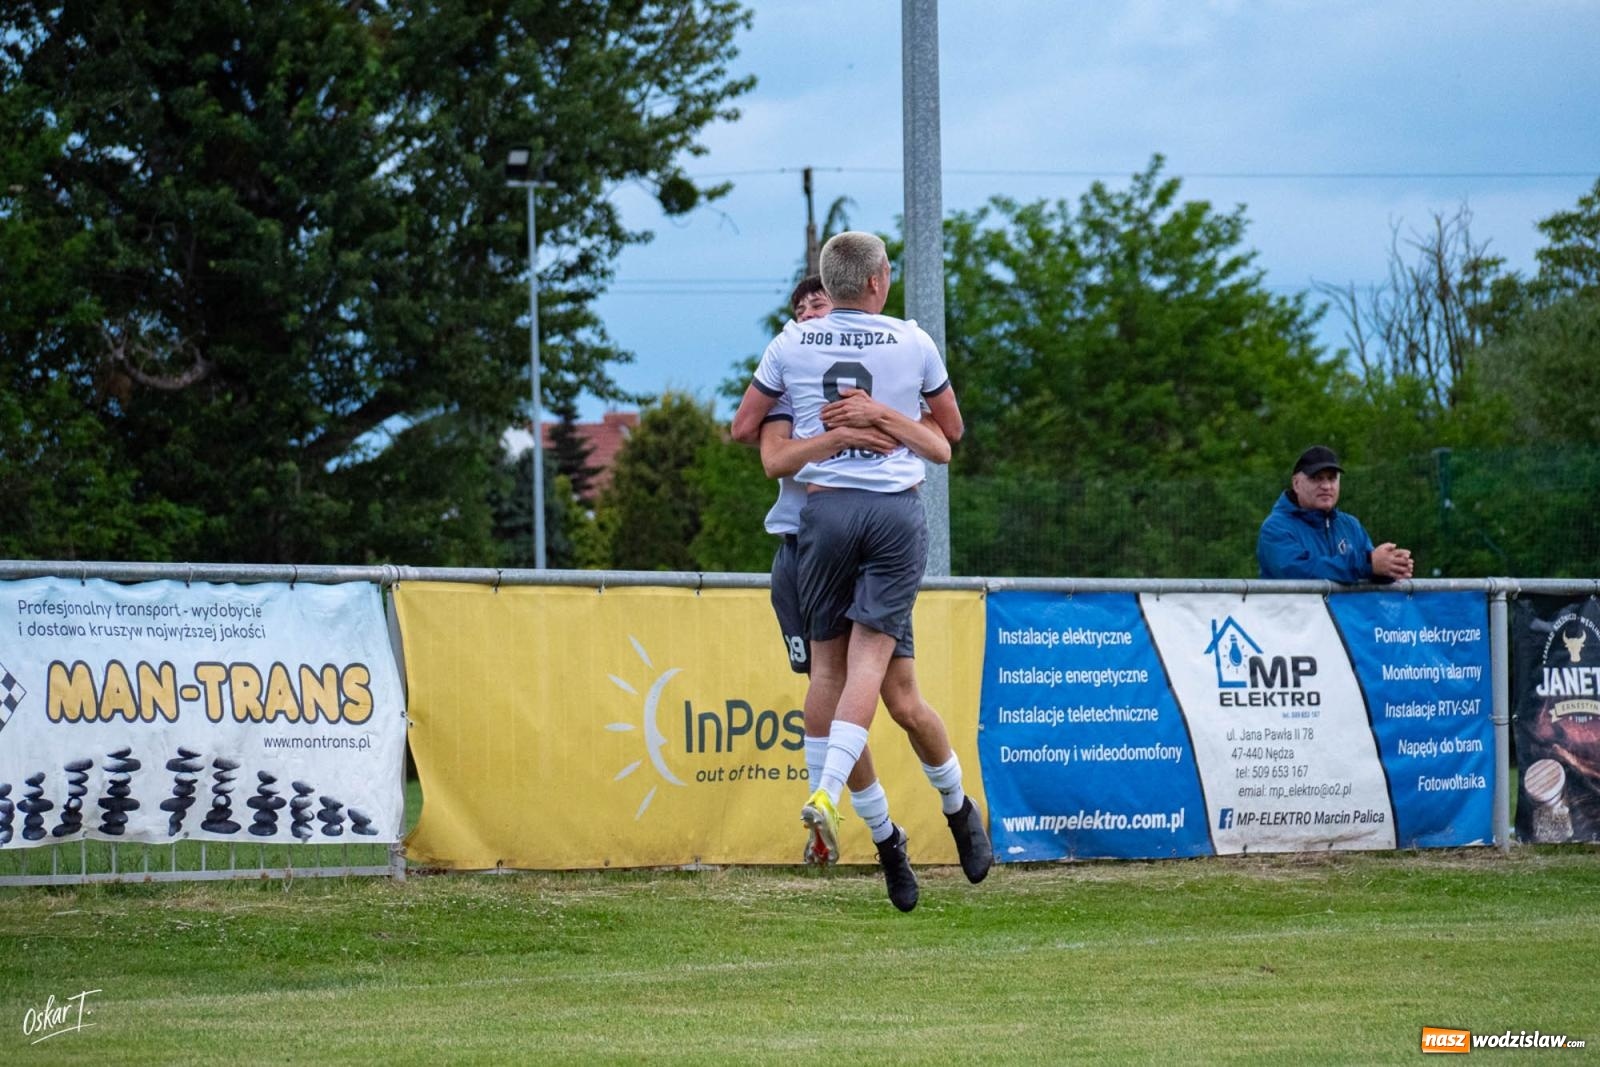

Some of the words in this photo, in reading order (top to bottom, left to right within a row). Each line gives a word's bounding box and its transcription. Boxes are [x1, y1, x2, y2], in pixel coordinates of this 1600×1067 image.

[800, 331, 833, 346] 1908
[839, 332, 899, 350] NĘDZA
[17, 600, 111, 619] Profesjonalny
[115, 601, 181, 620] transport
[191, 603, 262, 621] wydobycie
[18, 622, 22, 636] i
[27, 621, 86, 637] dostawa
[89, 622, 143, 641] kruszyw
[146, 622, 217, 642] najwyższej
[219, 622, 266, 642] jakości
[998, 627, 1060, 648] Instalacje
[1062, 627, 1132, 648] elektryczne
[1374, 627, 1417, 647] Pomiary
[1419, 626, 1481, 646] elektryczne
[998, 666, 1063, 687] Instalacje
[1065, 667, 1148, 687] energetyczne
[1250, 655, 1318, 689] MP
[1382, 664, 1440, 684] Monitoring
[1440, 665, 1446, 680] i
[1447, 664, 1483, 682] alarmy
[1536, 667, 1600, 696] JANET
[46, 659, 374, 724] MAN-TRANS
[1219, 691, 1321, 707] ELEKTRO
[998, 706, 1065, 727] Instalacje
[1067, 704, 1159, 723] teletechniczne
[1385, 701, 1437, 721] Instalacje
[1438, 699, 1481, 716] RTV-SAT
[684, 699, 805, 753] InPos
[1226, 728, 1236, 741] ul.
[1240, 728, 1262, 741] Jana
[1264, 728, 1292, 741] Pawła
[1302, 728, 1314, 740] 78
[263, 734, 371, 750] www.mantrans.pl
[1398, 738, 1438, 759] Napędy
[1440, 738, 1454, 754] do
[1455, 737, 1483, 753] bram
[1000, 745, 1069, 766] Domofony
[1073, 745, 1078, 761] i
[1082, 742, 1183, 763] wideodomofony
[1231, 747, 1264, 760] 47-440
[1265, 747, 1294, 762] Nędza
[696, 767, 725, 782] out
[728, 764, 746, 781] of
[747, 763, 781, 780] the
[787, 764, 810, 780] bo
[1251, 766, 1269, 778] 509
[1271, 766, 1289, 778] 653
[1292, 765, 1309, 777] 167
[1268, 782, 1352, 799] mp_elektro@o2.pl
[1418, 773, 1486, 792] Fotowoltaika
[1002, 807, 1185, 834] www.mpelektro.com.pl
[1236, 811, 1312, 826] MP-ELEKTRO
[1314, 810, 1350, 825] Marcin
[1352, 809, 1385, 824] Palica
